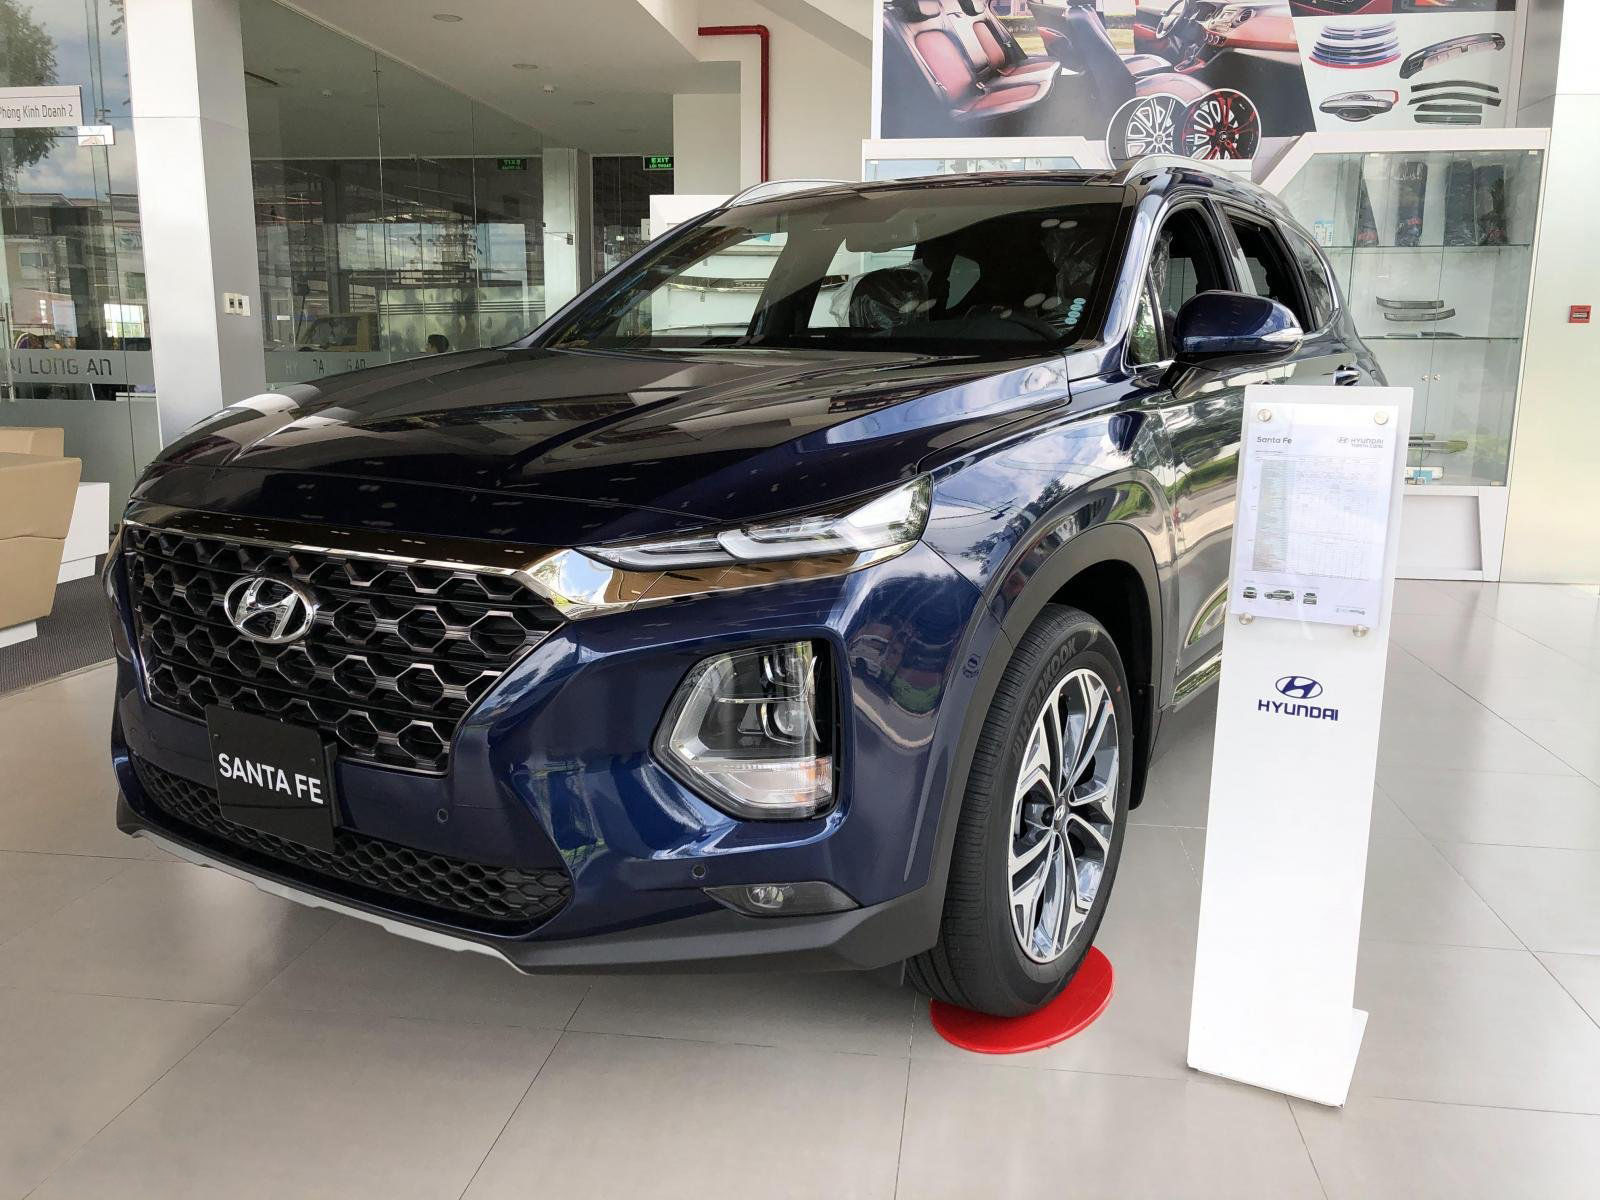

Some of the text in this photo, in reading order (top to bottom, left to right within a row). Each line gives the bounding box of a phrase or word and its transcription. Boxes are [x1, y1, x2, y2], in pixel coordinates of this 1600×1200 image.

[23, 105, 39, 118] Kinh
[42, 104, 66, 118] Doanh
[68, 104, 73, 117] 2
[1256, 436, 1281, 444] Santa
[1258, 699, 1339, 721] HYUNDAI
[218, 752, 324, 805] SANTA FE
